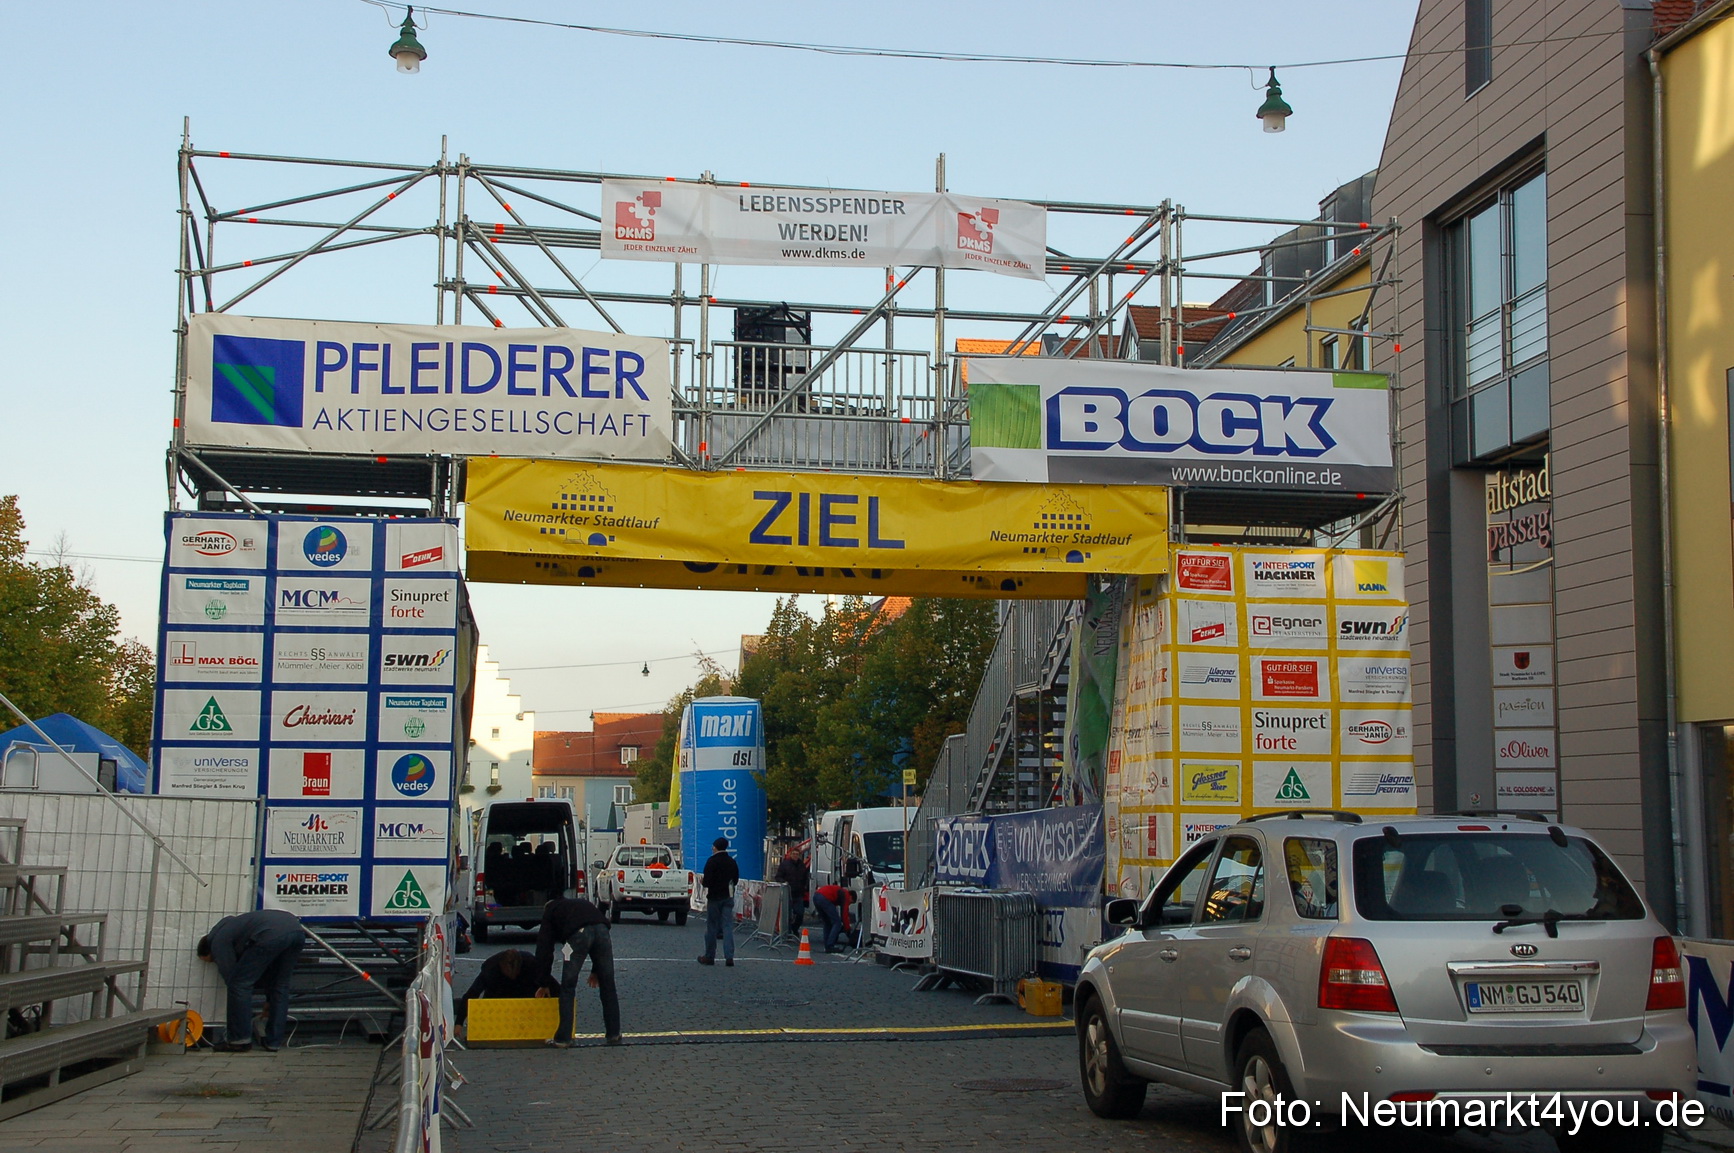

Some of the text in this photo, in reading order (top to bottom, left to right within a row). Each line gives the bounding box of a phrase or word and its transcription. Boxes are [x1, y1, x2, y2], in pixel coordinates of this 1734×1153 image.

[739, 194, 905, 215] LEBENSSPENDER
[617, 226, 653, 240] DKMS
[778, 222, 868, 242] WERDEN!
[623, 243, 698, 254] JEDER EINZELNE ZÄHLT
[959, 236, 991, 253] DKMS
[781, 247, 866, 260] www.dkms.de
[964, 252, 983, 261] JEDER
[983, 255, 1011, 267] EINZELNE
[314, 340, 651, 401] PFLEIDERER
[312, 406, 651, 437] AKTIENGESELLSCHAFT
[1046, 385, 1338, 458] BOCK
[1171, 464, 1342, 486] www.bockonline.de
[503, 509, 660, 530] Neumarkter Stadtlauf
[749, 490, 905, 549] ZIEL
[989, 529, 1132, 546] Neumarkter Stadtlauf
[1487, 508, 1553, 562] passag
[308, 551, 341, 562] vedes
[412, 552, 432, 563] DEHN
[1181, 557, 1225, 567] GUT FÜR SIE!
[1262, 561, 1316, 569] INTERSPORT
[1254, 570, 1316, 580] HACKNER
[188, 580, 246, 590] Neumarkter Tagblatt
[281, 589, 339, 607] MCM
[391, 588, 450, 605] Sinupret
[391, 605, 425, 618] forte
[1272, 617, 1322, 630] Egner
[1340, 620, 1387, 634] swn
[1200, 628, 1216, 638] DEHN
[198, 655, 259, 666] MAX BÖGL
[277, 662, 313, 670] Mümmler
[346, 662, 364, 670] Kölbl
[383, 653, 430, 666] swn
[1209, 667, 1235, 677] Wagner
[1266, 663, 1313, 672] GUT FÜR SIE!
[388, 698, 444, 707] Neumarkter Tagblatt
[282, 704, 356, 728] Charivari
[1254, 711, 1327, 733] Sinupret
[700, 710, 753, 738] maxi
[1256, 733, 1297, 750] forte
[1500, 740, 1550, 758] s.Oliver
[732, 750, 752, 766] dsl
[303, 775, 329, 788] Braun
[396, 780, 429, 791] vedes
[1191, 770, 1228, 791] Glossner
[1210, 780, 1228, 790] Bier
[1380, 773, 1413, 785] Wagner
[379, 822, 424, 838] MCM
[283, 831, 345, 845] NEUMARKTER
[287, 873, 349, 882] INTERSPORT
[276, 884, 348, 895] HACKNER
[1515, 945, 1535, 955] KIA
[1479, 985, 1506, 1005] NM
